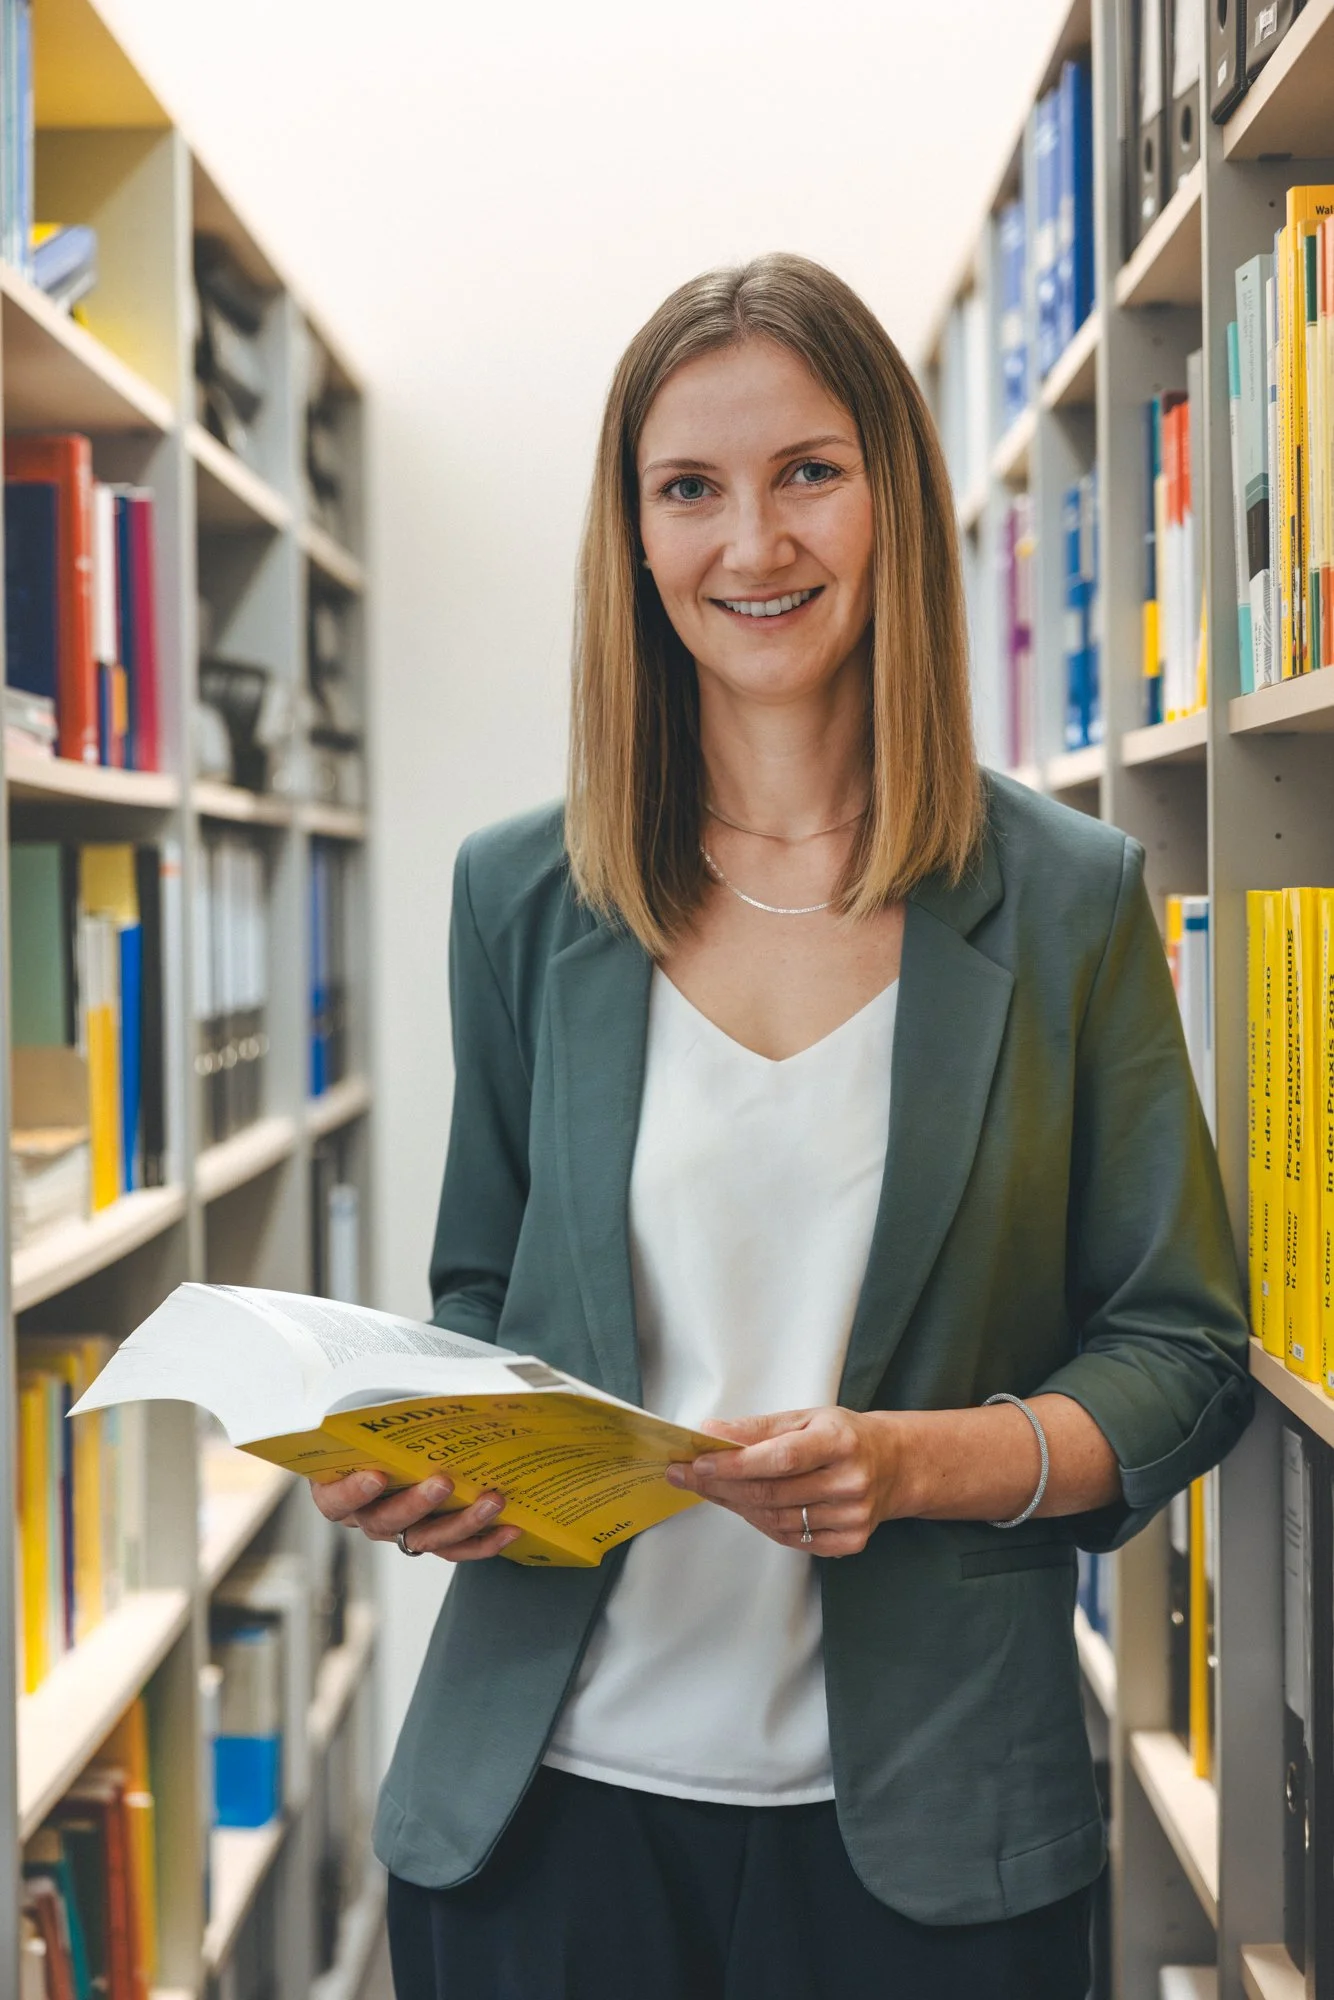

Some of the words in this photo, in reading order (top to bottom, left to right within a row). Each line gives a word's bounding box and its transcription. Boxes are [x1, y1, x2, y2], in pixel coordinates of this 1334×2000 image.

[1315, 205, 1334, 214] Wal
[1326, 1038, 1334, 1115] Praxis
[1326, 1121, 1334, 1164] der
[1264, 1150, 1271, 1171] in
[1293, 1161, 1301, 1182] in
[1326, 1171, 1334, 1194] in
[1263, 1259, 1269, 1273] H.
[1286, 1268, 1291, 1287] W.
[1291, 1273, 1297, 1289] H.
[1325, 1291, 1331, 1309] H.
[359, 1403, 476, 1434] KODEX
[427, 1427, 541, 1462] GESETZE
[592, 1519, 635, 1545] Linde
